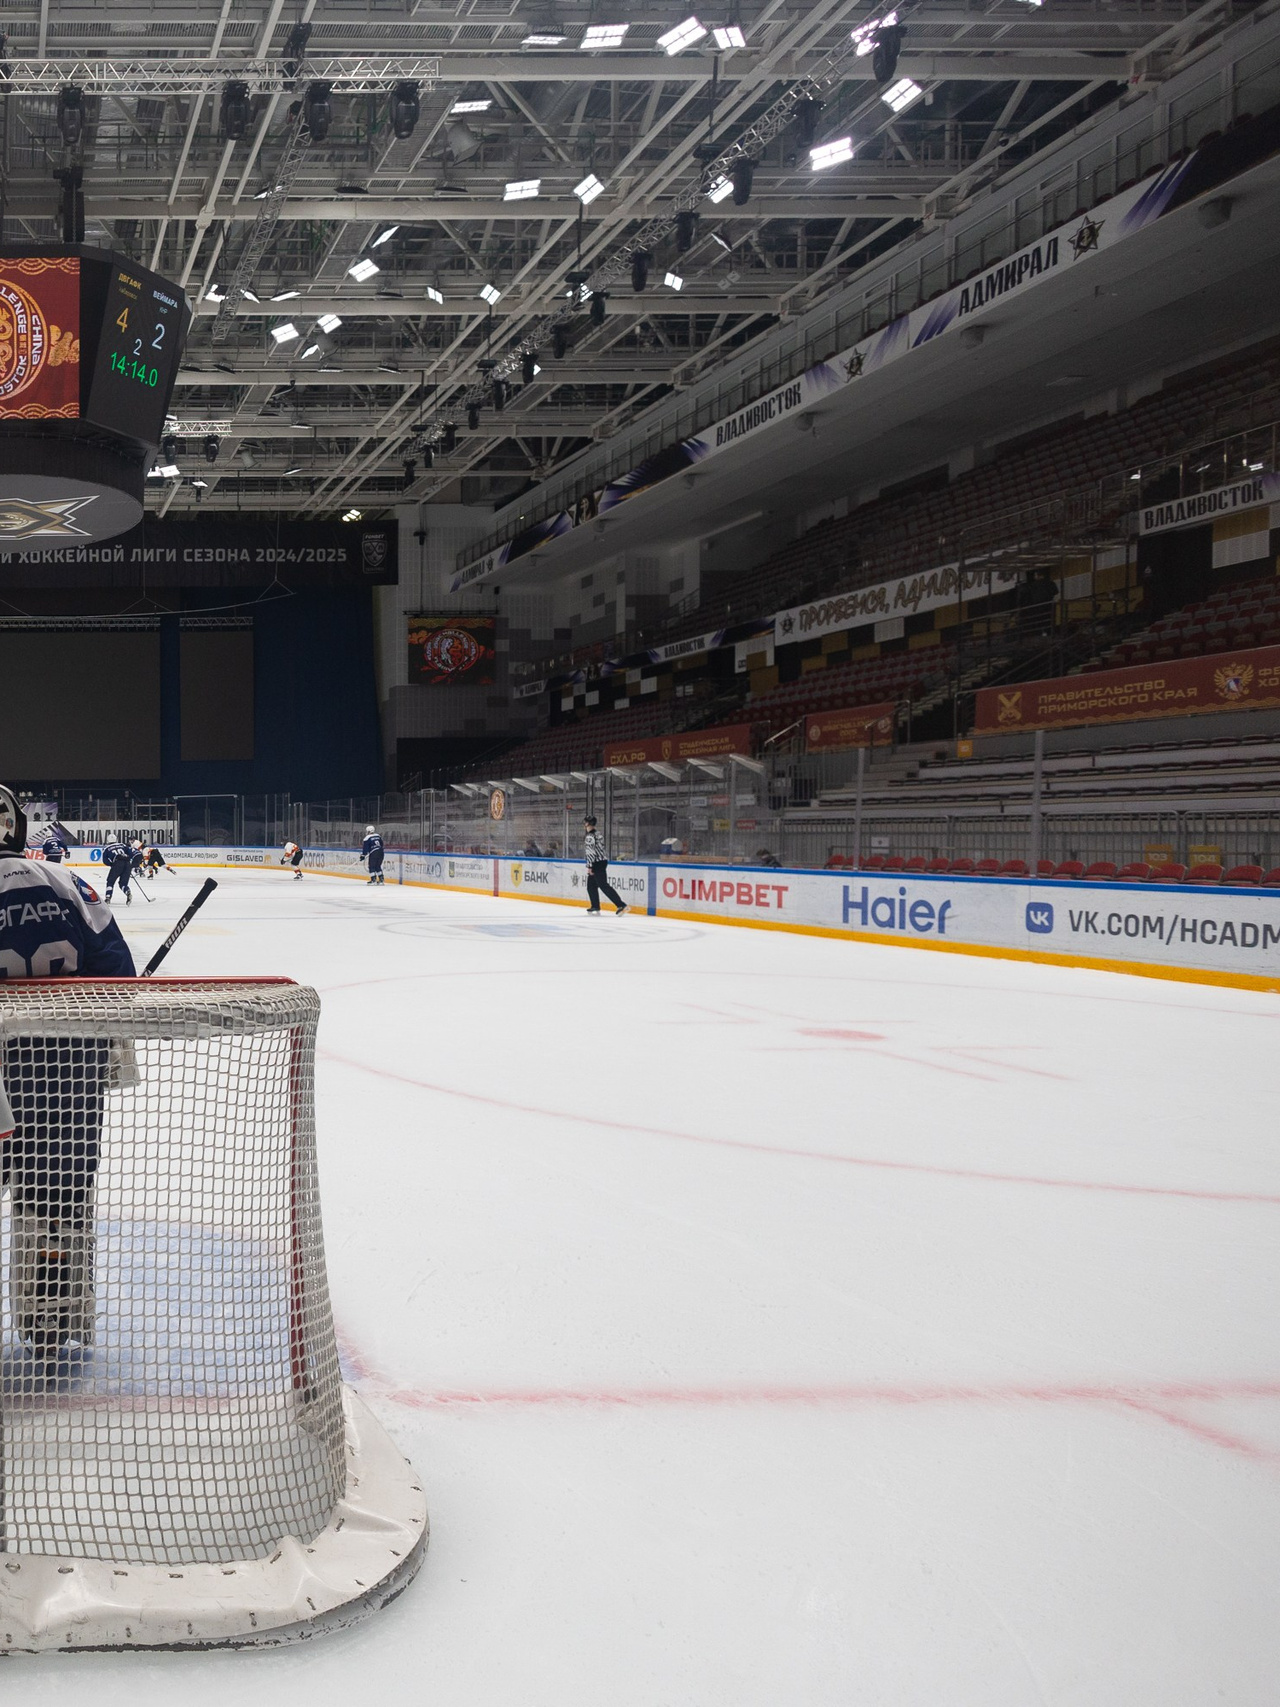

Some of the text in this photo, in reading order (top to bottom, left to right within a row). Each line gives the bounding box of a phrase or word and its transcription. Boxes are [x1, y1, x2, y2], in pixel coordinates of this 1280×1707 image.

[958, 236, 1058, 317] АДМИРАЛ
[152, 290, 178, 309] ВЕЙМАРА
[116, 307, 129, 333] 4
[133, 338, 143, 356] 2
[151, 323, 166, 350] 2
[111, 351, 158, 387] 14:14.0
[716, 382, 802, 447] ВЛАДИВОСТОК
[1144, 479, 1264, 529] ВЛАДИВОСТОК
[19, 544, 125, 563] ХОККЕЙНОЙ
[130, 548, 177, 562] ЛИГИ
[183, 549, 251, 562] СЕЗОНА
[255, 549, 347, 562] 2024/2025
[1037, 693, 1149, 714] ПРИМОРСКОГО
[1152, 687, 1199, 701] КРАЯ
[1038, 679, 1166, 704] ПРАВИТЕЛЬСТВО
[610, 737, 730, 764] СХЛ.РФ СТУДЕНЧЕСКАЯ
[51, 841, 59, 849] 2
[1148, 853, 1168, 861] 103
[226, 854, 263, 863] GISLAVED
[303, 852, 325, 868] согаз
[1193, 854, 1216, 863] 104
[524, 871, 549, 884] БАНК
[662, 877, 788, 909] OLIMPBET
[842, 884, 952, 934] Haier
